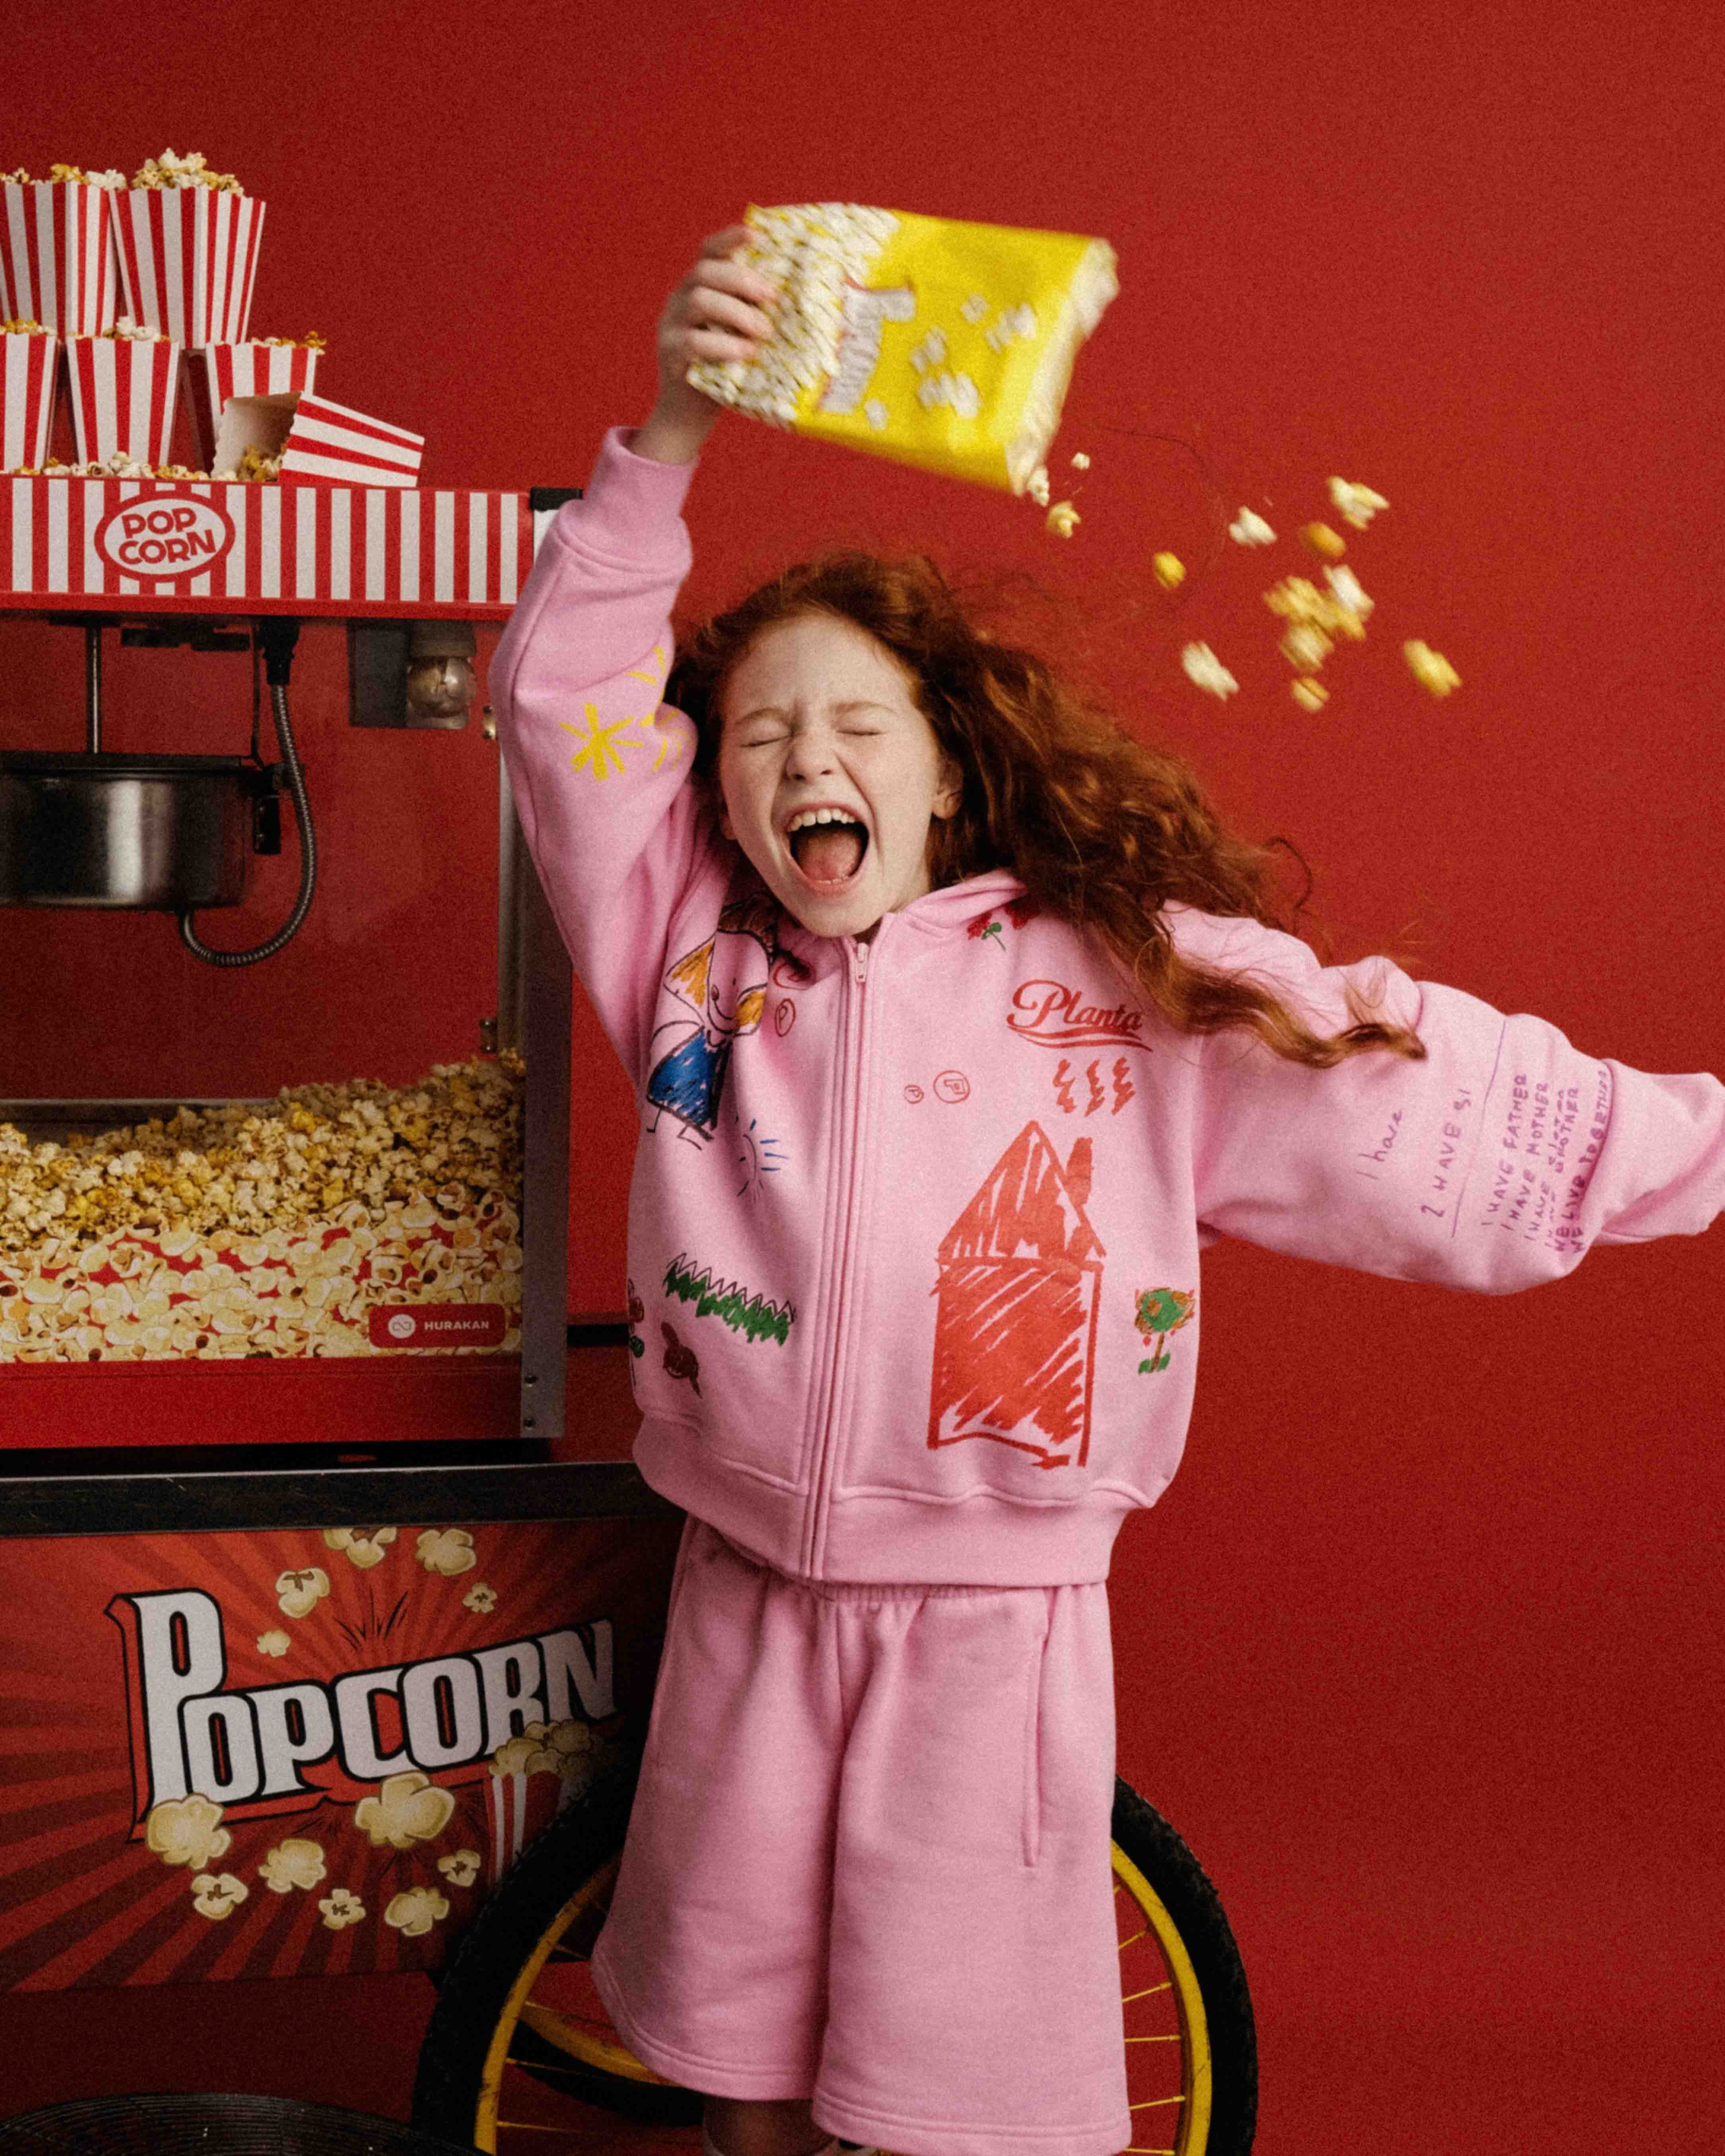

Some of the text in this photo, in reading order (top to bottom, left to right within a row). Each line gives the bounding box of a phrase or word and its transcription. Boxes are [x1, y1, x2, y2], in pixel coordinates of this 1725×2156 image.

[118, 529, 216, 565] CORN
[122, 507, 197, 539] POP
[1006, 979, 1143, 1030] Planta
[1432, 1122, 1461, 1190] HAVE
[1488, 1159, 1513, 1212] HAVE
[1503, 1074, 1528, 1149] FATHER
[1510, 1170, 1535, 1220] HAVE
[1526, 1082, 1548, 1155] MOTHER
[1528, 1182, 1550, 1231] HAVE
[1555, 1225, 1570, 1251] WE
[424, 1320, 489, 1331] HURAKAN
